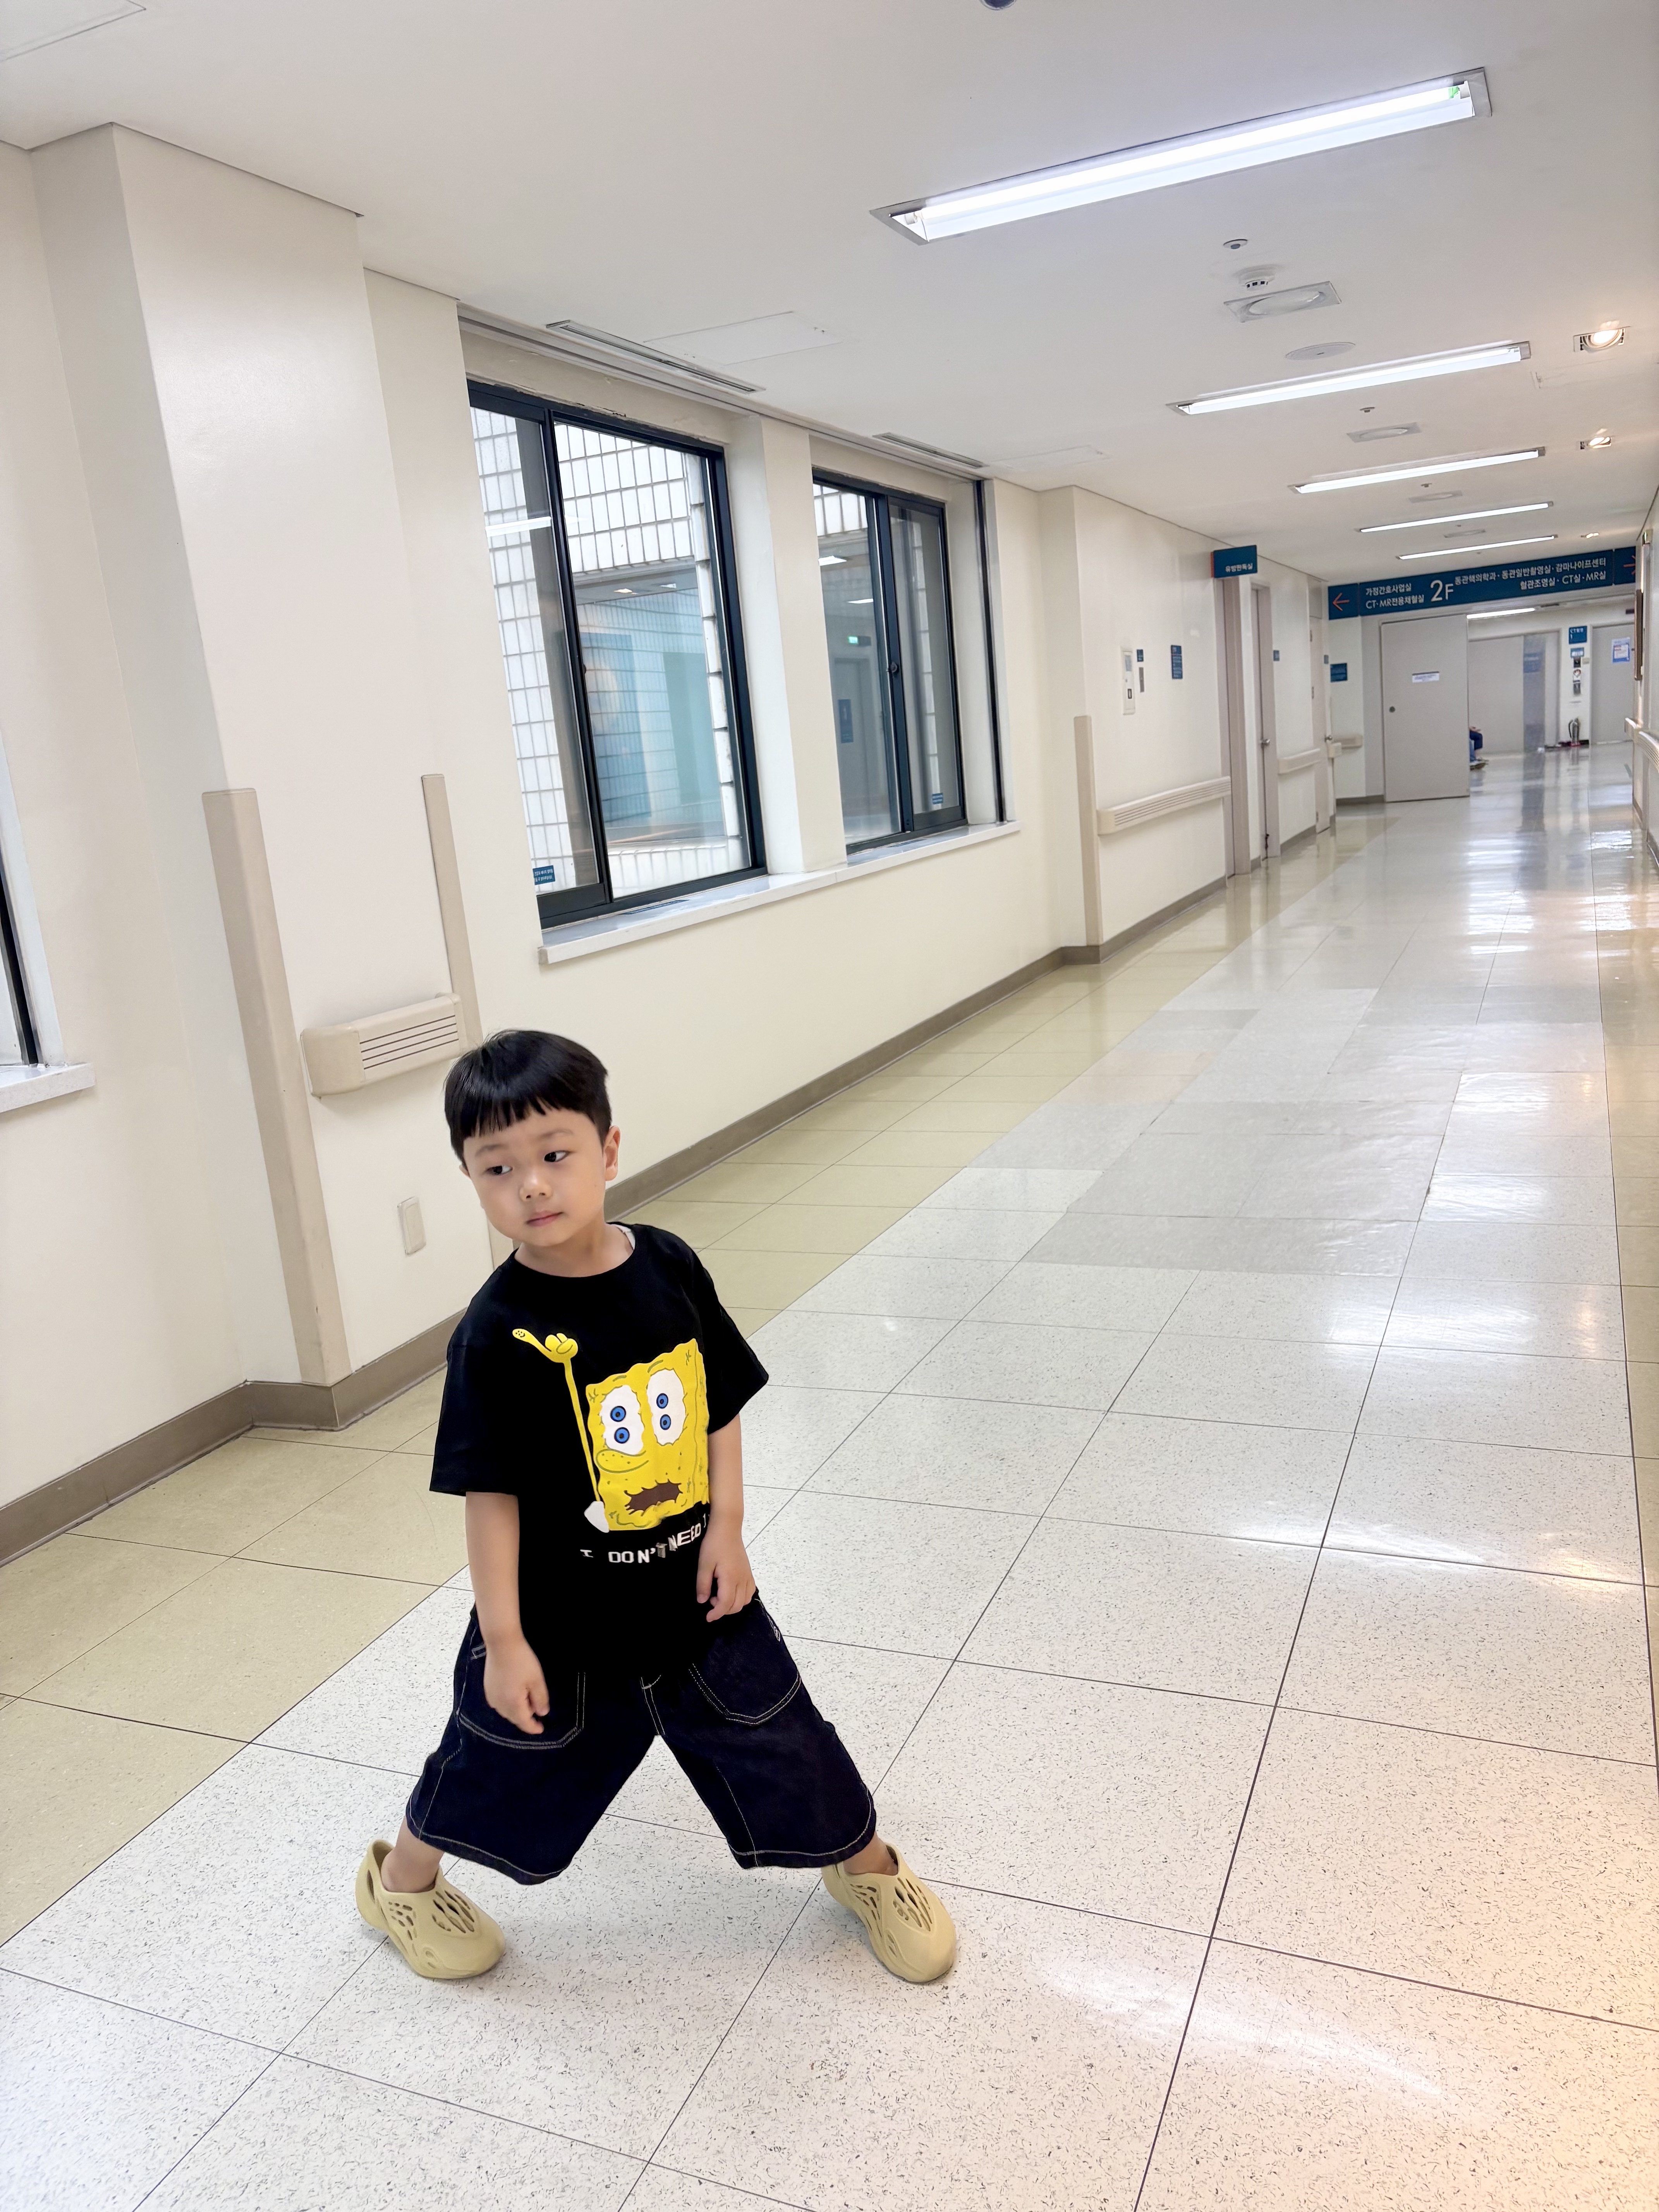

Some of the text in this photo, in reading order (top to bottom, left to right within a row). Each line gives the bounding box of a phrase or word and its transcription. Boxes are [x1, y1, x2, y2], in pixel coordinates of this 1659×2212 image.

[1556, 558, 1606, 572] 감마나이프센터
[1366, 583, 1412, 596] 가정간호사업실
[1520, 570, 1606, 590] 혈관조영실 CT실 MR실
[1431, 580, 1453, 602] 2F
[580, 1549, 594, 1558] I
[608, 1542, 668, 1563] DON'T
[668, 1523, 701, 1551] NEED
